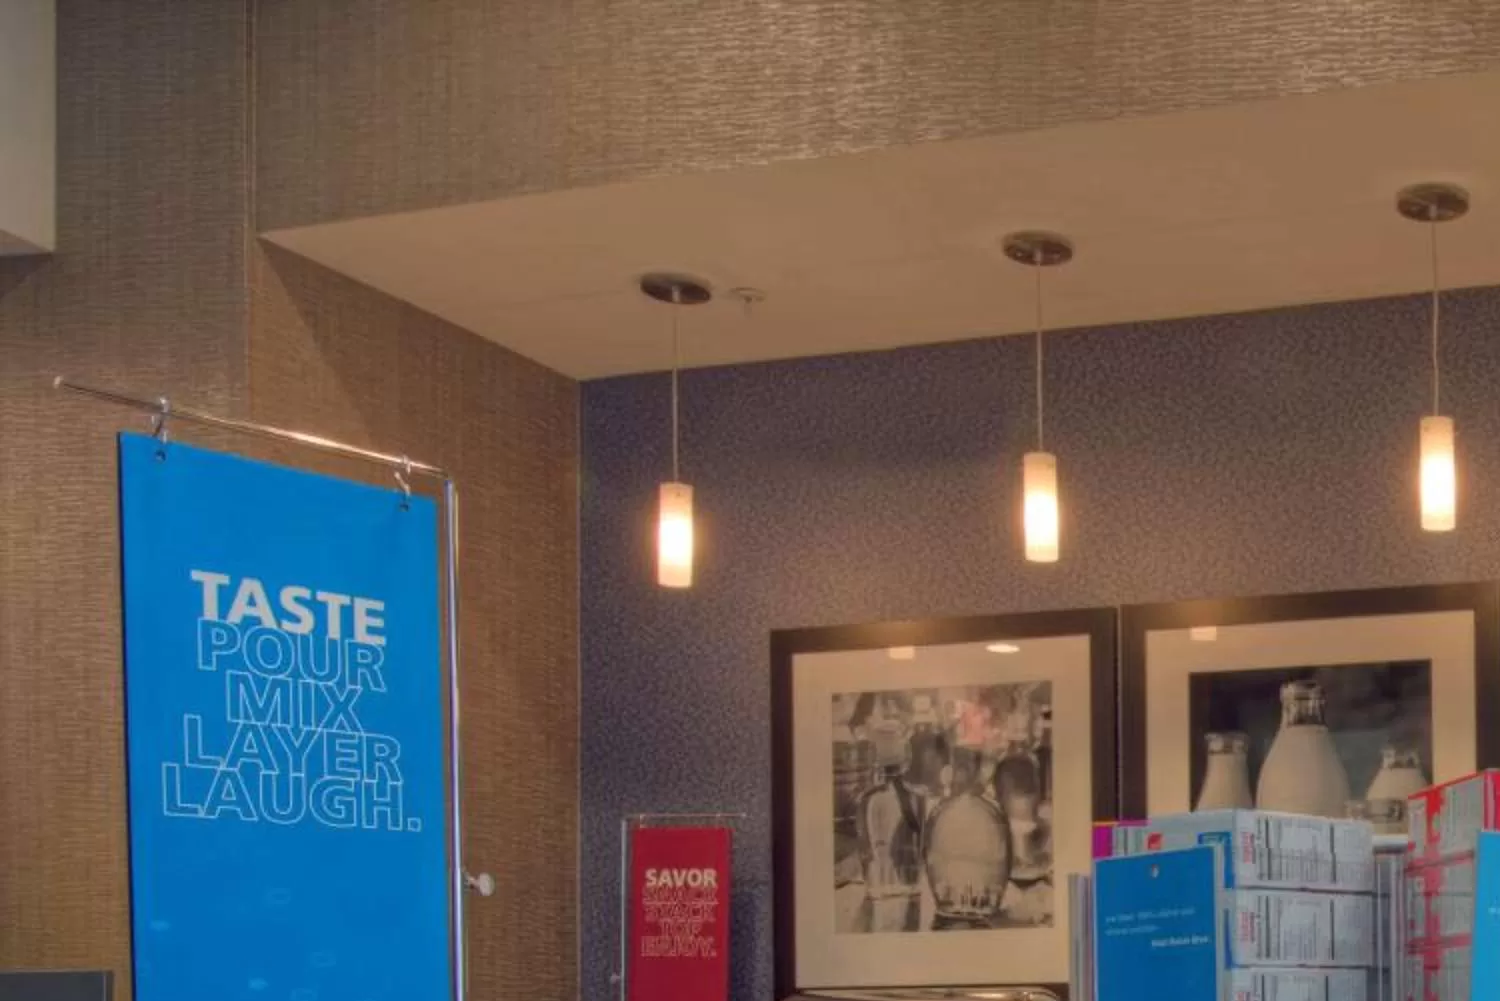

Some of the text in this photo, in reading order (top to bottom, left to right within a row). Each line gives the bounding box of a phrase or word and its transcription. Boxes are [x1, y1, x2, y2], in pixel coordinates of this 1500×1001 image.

[190, 569, 387, 646] TASTE
[197, 617, 387, 693] POUR
[226, 670, 363, 735] MIX
[184, 714, 405, 787] LAYER
[161, 763, 422, 832] LAUGH.
[645, 867, 718, 889] SAVOR
